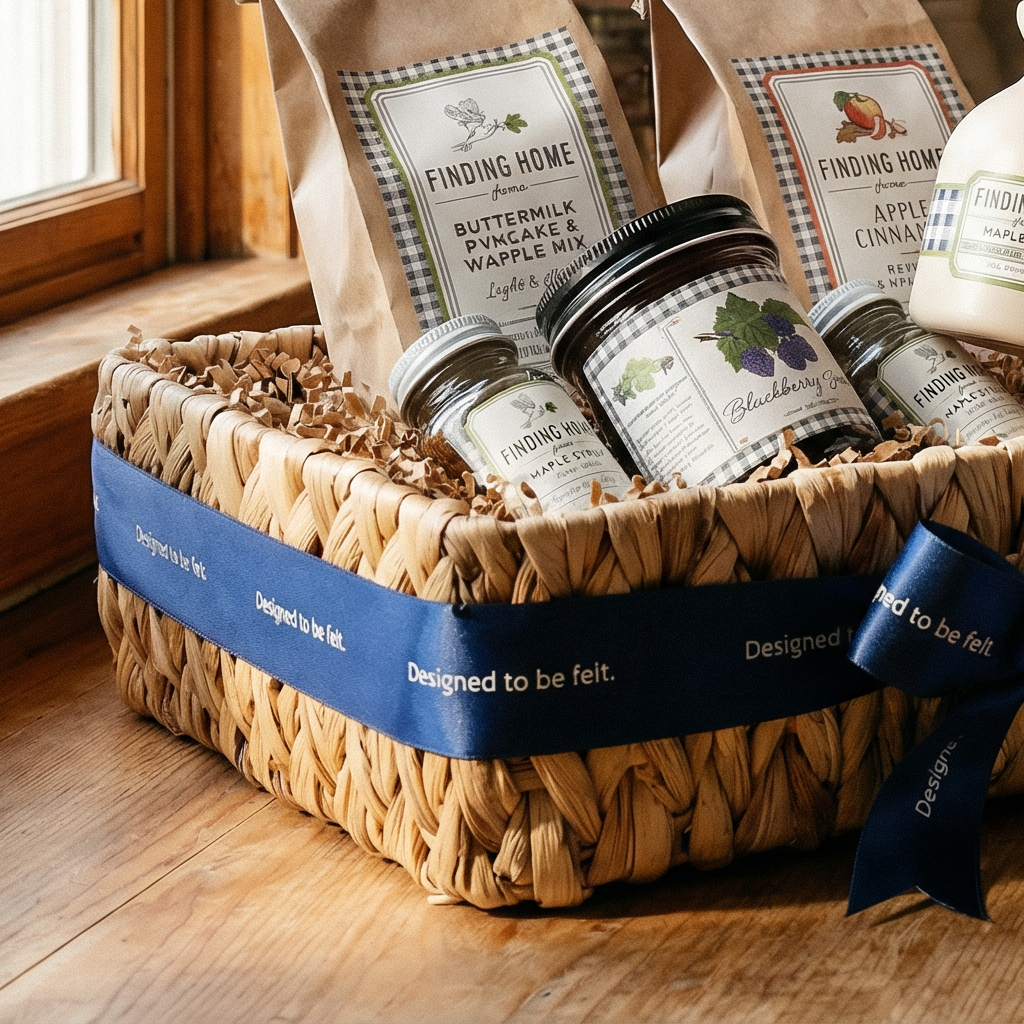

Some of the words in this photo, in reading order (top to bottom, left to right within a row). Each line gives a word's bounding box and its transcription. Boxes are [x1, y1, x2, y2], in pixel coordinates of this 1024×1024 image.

[424, 154, 512, 192] FINDING
[516, 141, 576, 175] HOME
[818, 152, 894, 181] FINDING
[454, 200, 577, 237] BUTTERMILK
[566, 218, 580, 232] &
[875, 199, 928, 223] APPLE
[463, 243, 546, 273] WAPPLE
[551, 234, 588, 255] MIX
[722, 376, 823, 425] Blackberry
[500, 424, 562, 466] FINDING
[530, 454, 571, 480] MAPLE
[256, 590, 298, 629] Designed
[299, 612, 310, 634] to
[311, 616, 326, 642] be
[908, 606, 932, 630] to
[933, 617, 962, 644] be
[744, 627, 841, 661] Designed
[407, 661, 497, 697] Designed
[503, 672, 530, 692] to
[536, 668, 566, 690] be
